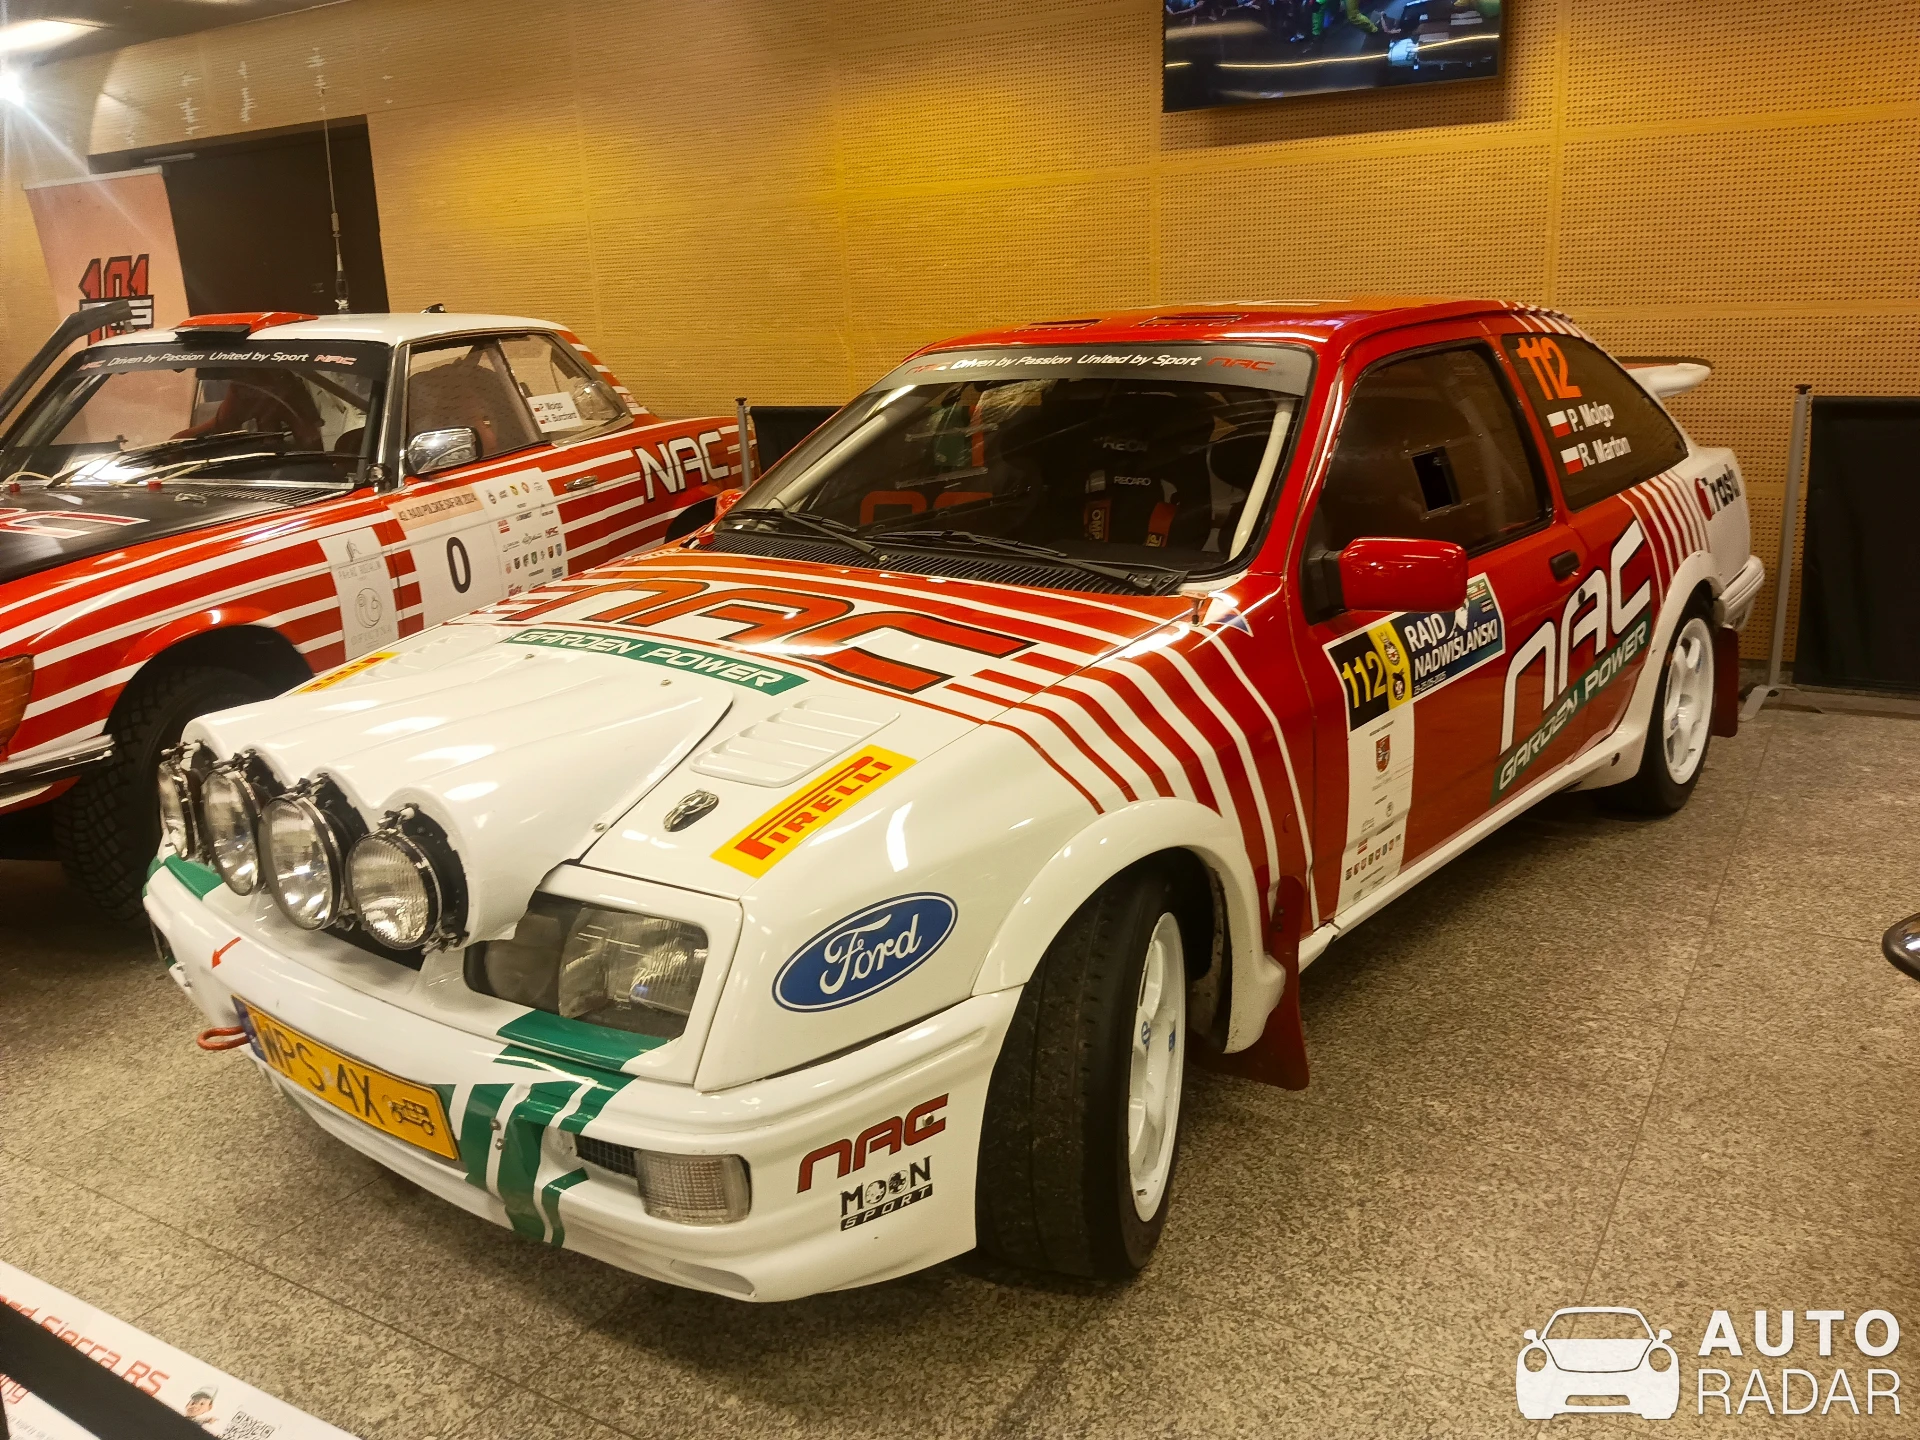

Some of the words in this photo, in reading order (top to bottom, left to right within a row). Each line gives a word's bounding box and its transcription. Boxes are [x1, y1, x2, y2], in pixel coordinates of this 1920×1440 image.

[107, 357, 142, 366] Driven
[142, 354, 160, 363] by
[159, 353, 204, 362] Passion
[209, 352, 251, 361] United
[251, 352, 270, 363] by
[273, 352, 309, 363] Sport
[950, 358, 994, 370] Driven
[995, 356, 1017, 368] by
[1015, 355, 1073, 366] Passion
[1077, 354, 1130, 364] United
[1129, 355, 1153, 366] by
[1152, 354, 1202, 367] Sport
[1516, 336, 1582, 400] 112
[1567, 407, 1584, 433] P.
[633, 430, 730, 502] NAC
[1113, 475, 1152, 487] RECARO
[1577, 442, 1596, 468] R.
[446, 536, 471, 593] 0
[513, 628, 633, 656] GARDEN
[653, 642, 789, 690] POWER
[1404, 612, 1446, 652] RAJD
[1413, 618, 1499, 681] NADWIŚLAŃSKI
[1341, 650, 1387, 709] 112
[1499, 689, 1578, 790] GARDEN
[1584, 620, 1648, 701] POWER
[733, 755, 893, 860] PIRELLI
[818, 913, 923, 995] Ford
[250, 1014, 327, 1092] WPS
[336, 1062, 387, 1126] 4X
[843, 1184, 931, 1230] SPORT
[121, 1359, 170, 1397] RS
